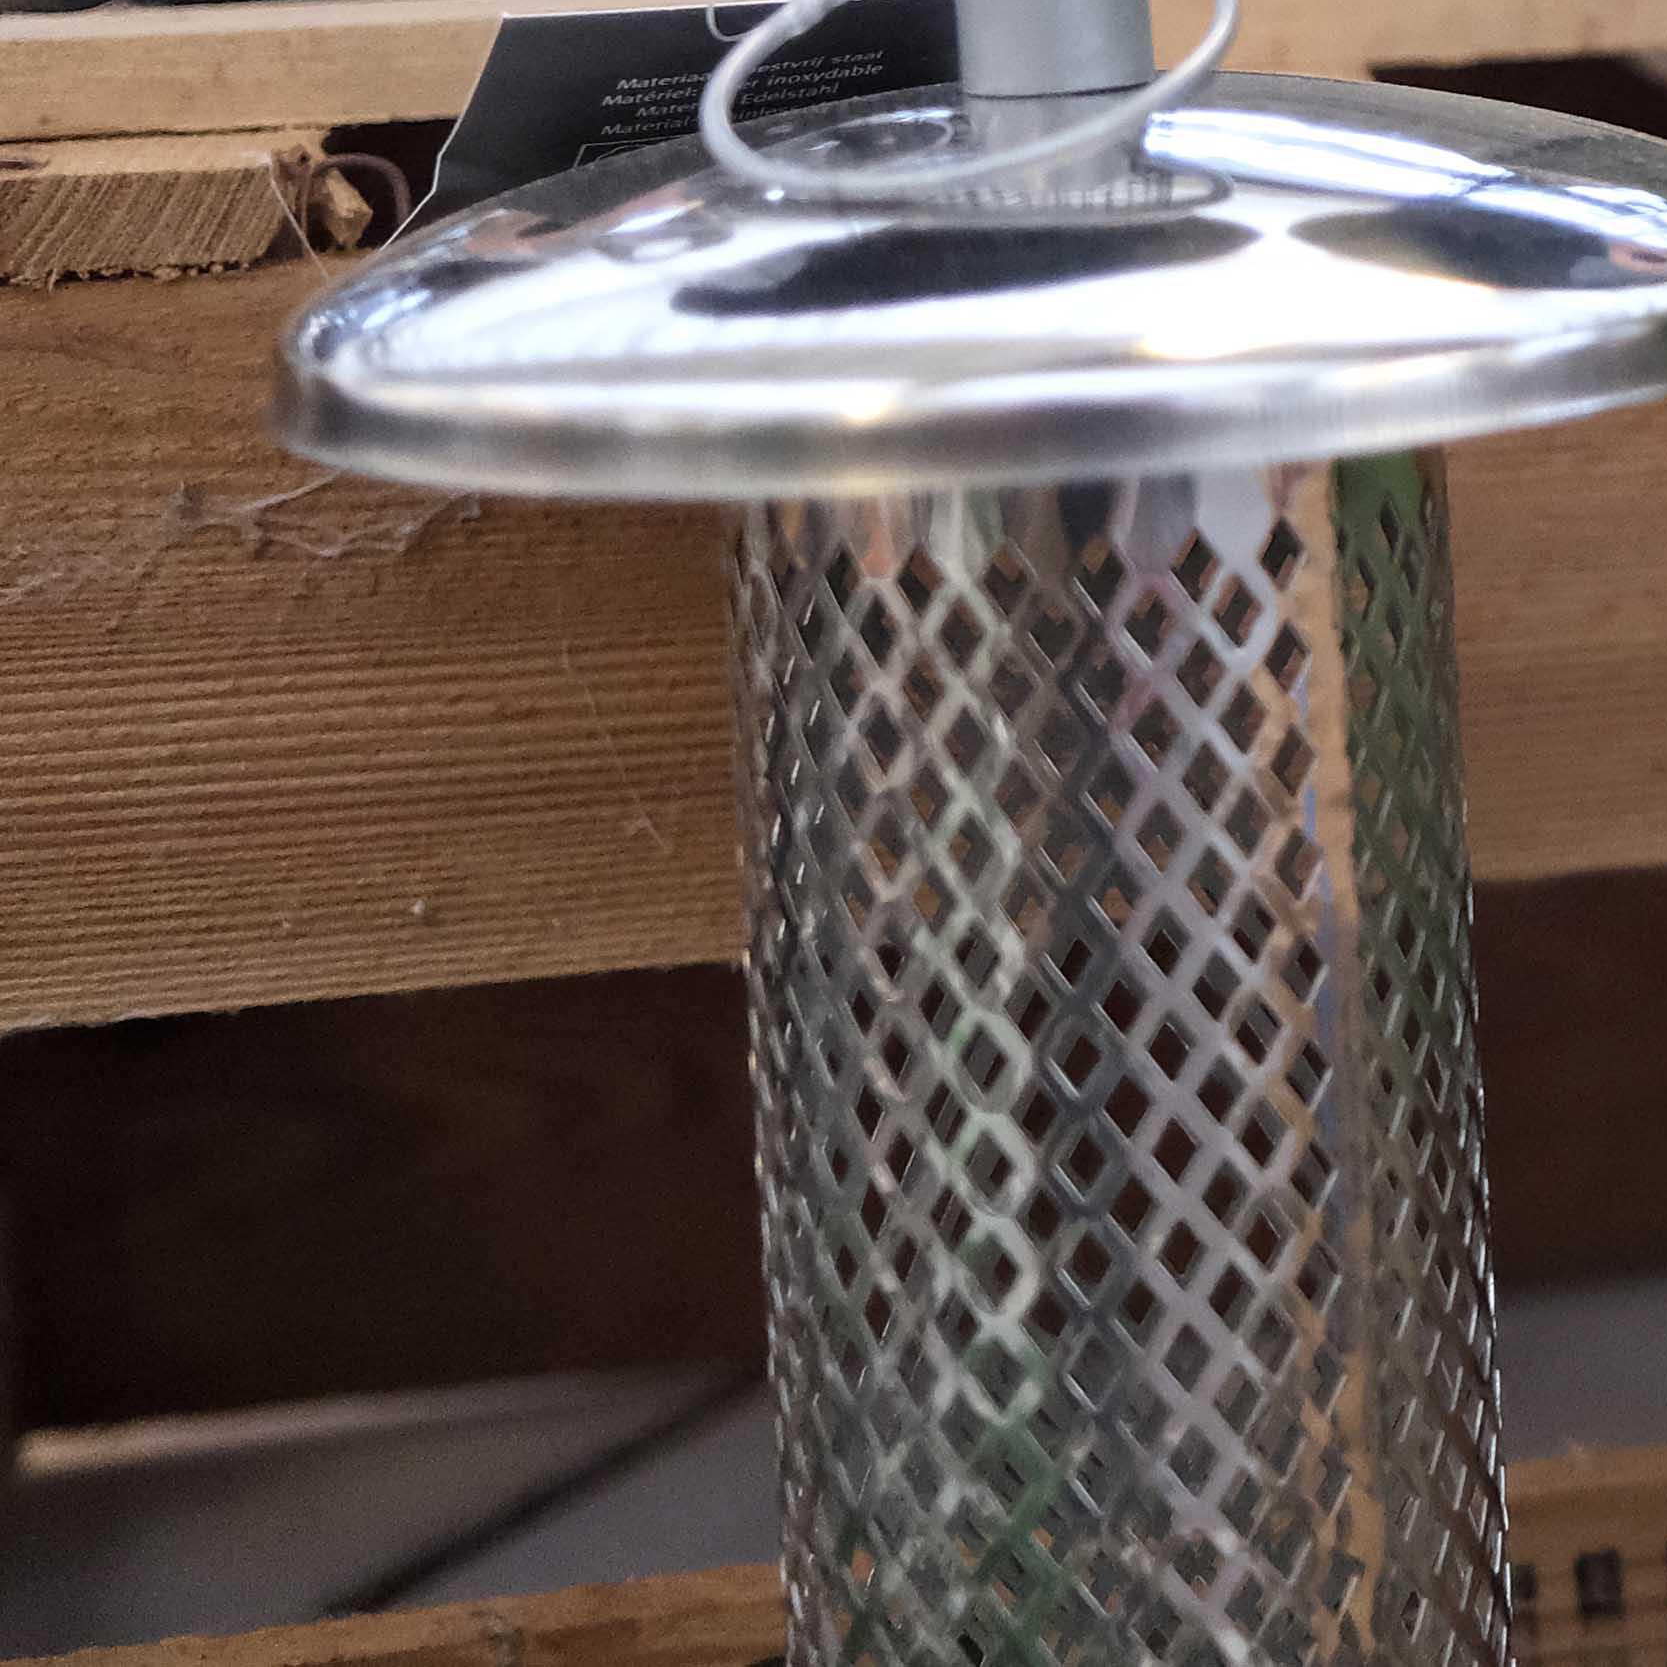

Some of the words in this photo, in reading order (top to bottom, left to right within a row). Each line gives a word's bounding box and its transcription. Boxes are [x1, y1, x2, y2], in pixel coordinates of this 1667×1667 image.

[831, 49, 884, 64] staal
[601, 86, 698, 107] Matériel:
[767, 64, 884, 86] inoxydable
[740, 83, 840, 105] Edelstahl
